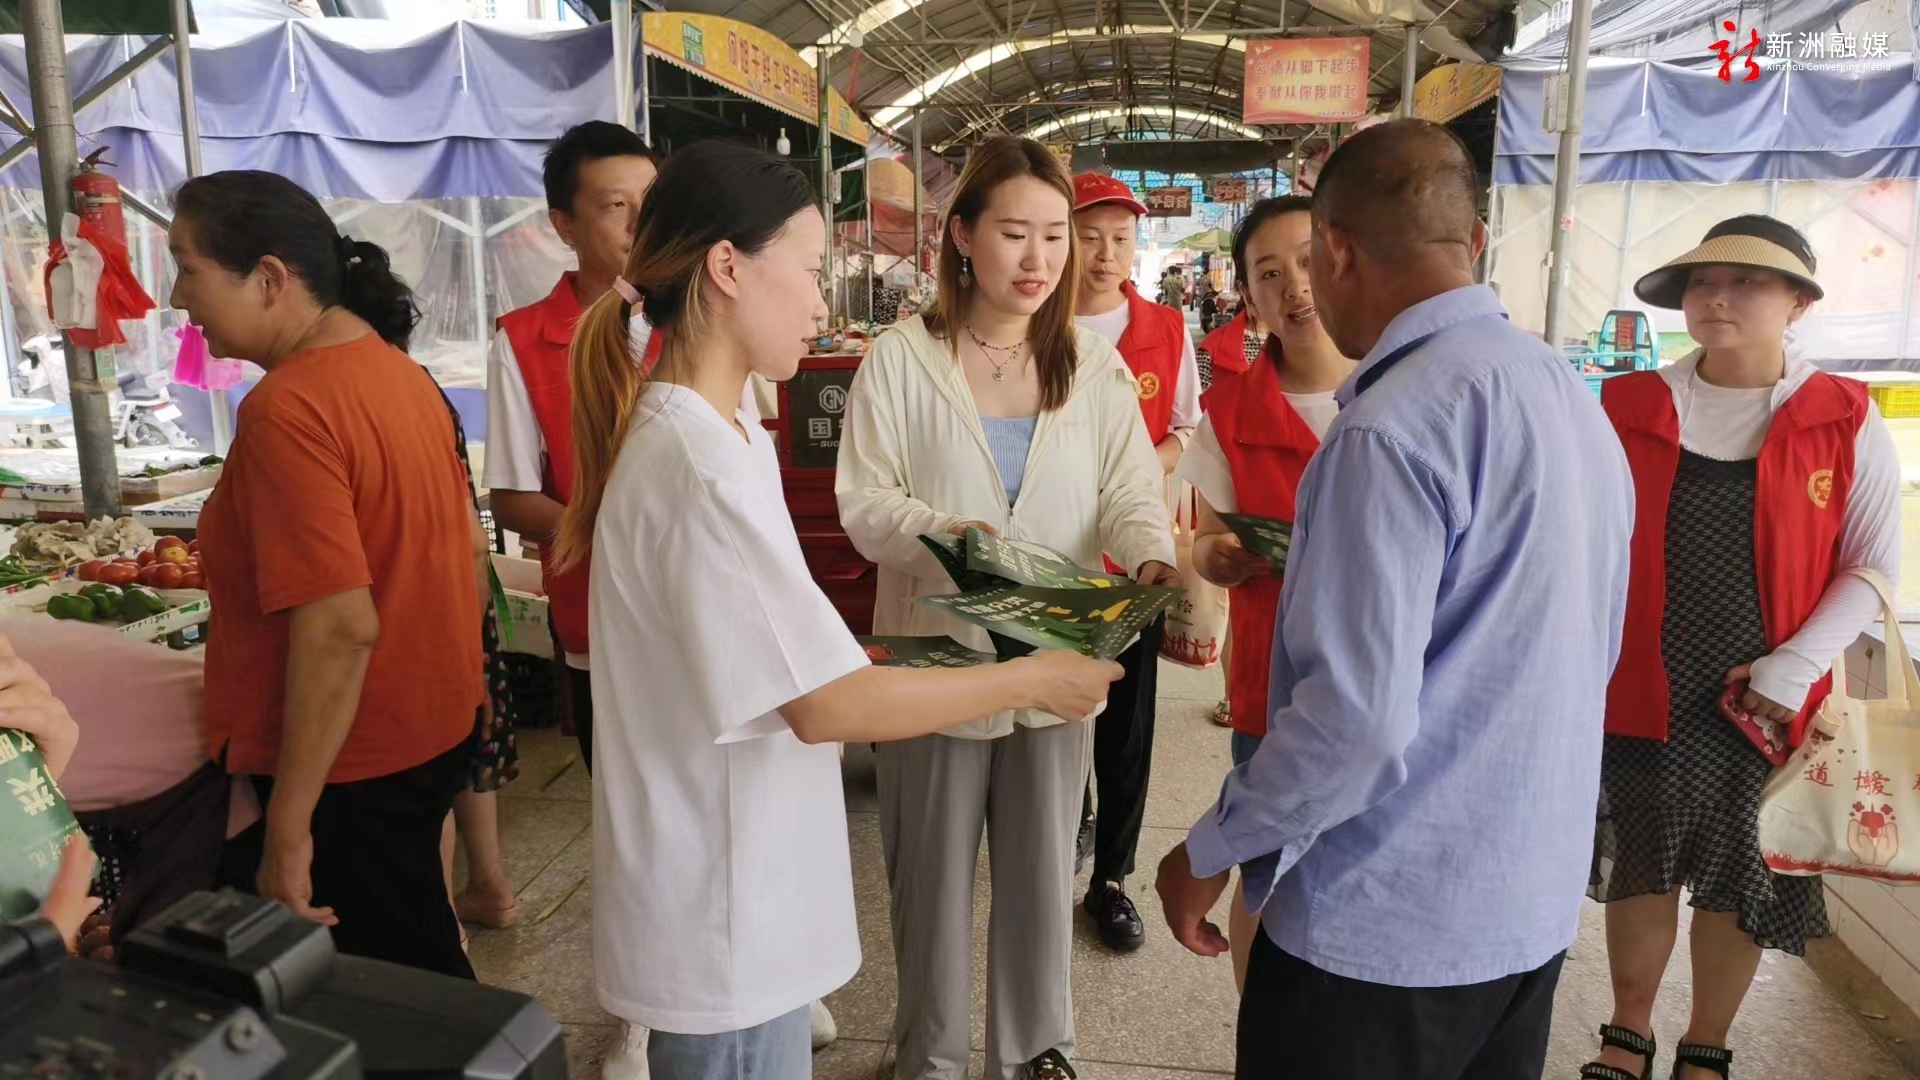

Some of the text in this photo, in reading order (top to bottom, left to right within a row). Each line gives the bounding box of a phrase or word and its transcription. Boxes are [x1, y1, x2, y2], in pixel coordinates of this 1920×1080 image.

[1255, 57, 1361, 76] 公德从脚下起步
[1255, 84, 1358, 101] 奉献从你我做起
